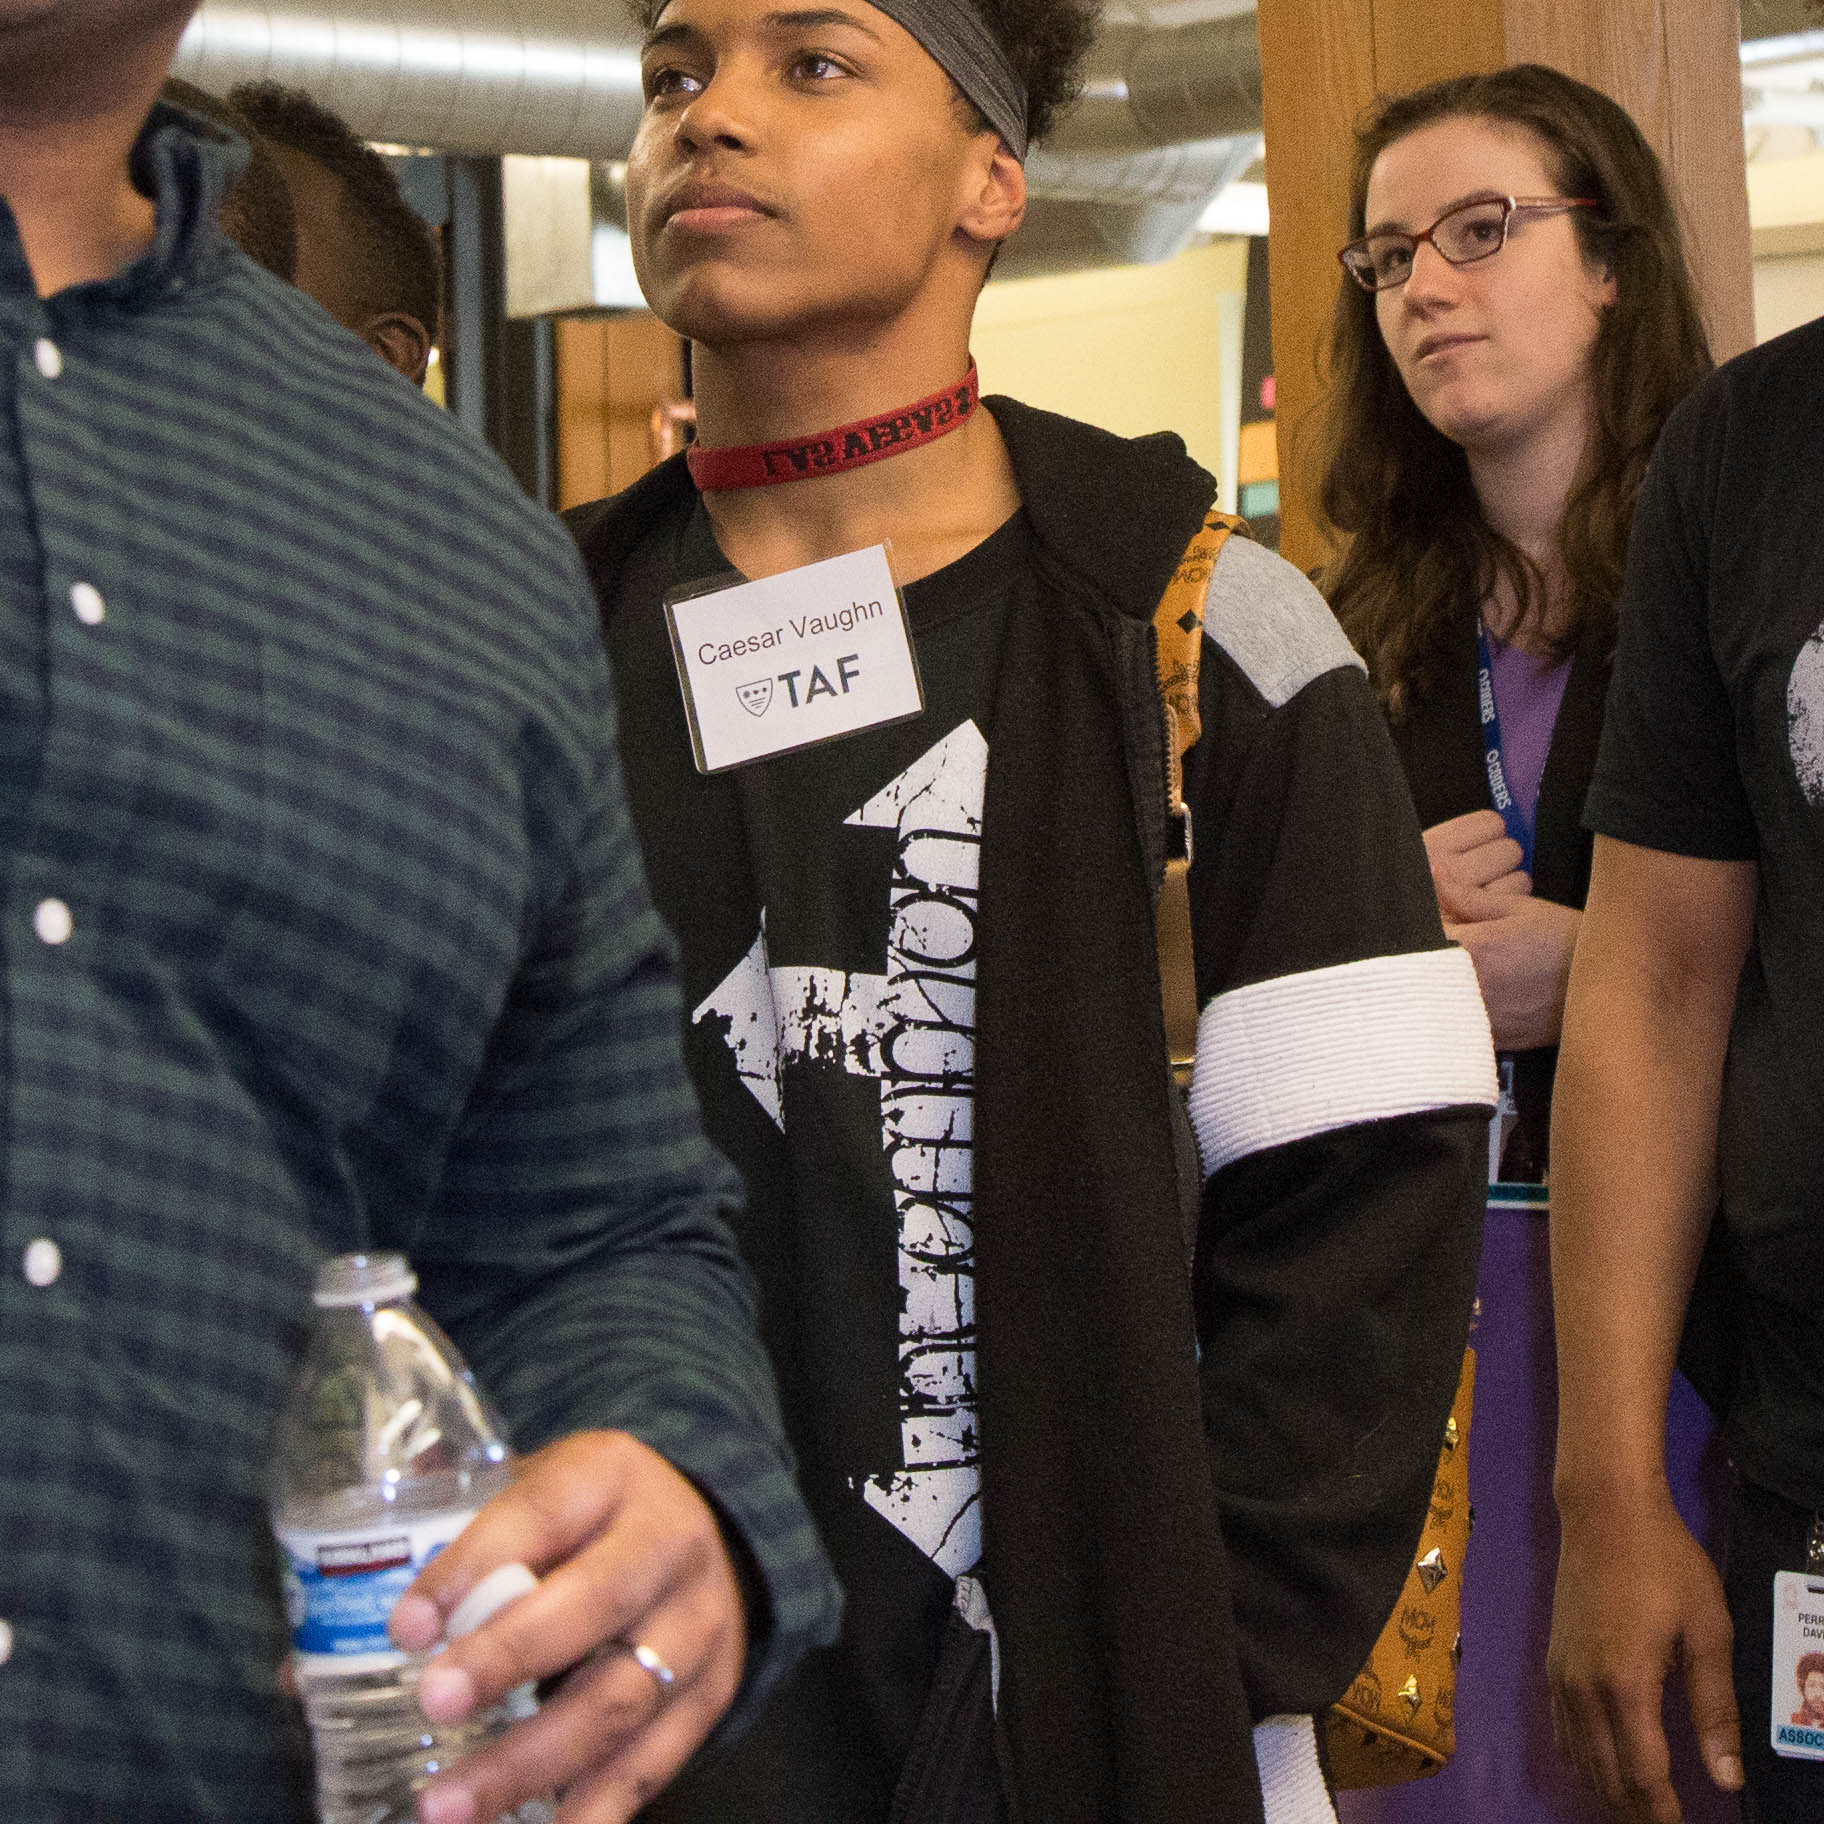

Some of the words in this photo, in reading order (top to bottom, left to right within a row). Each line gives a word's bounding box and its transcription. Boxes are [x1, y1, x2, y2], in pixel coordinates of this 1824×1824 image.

[697, 627, 784, 666] Caesar
[789, 600, 884, 639] Vaughn
[777, 653, 860, 708] TAF
